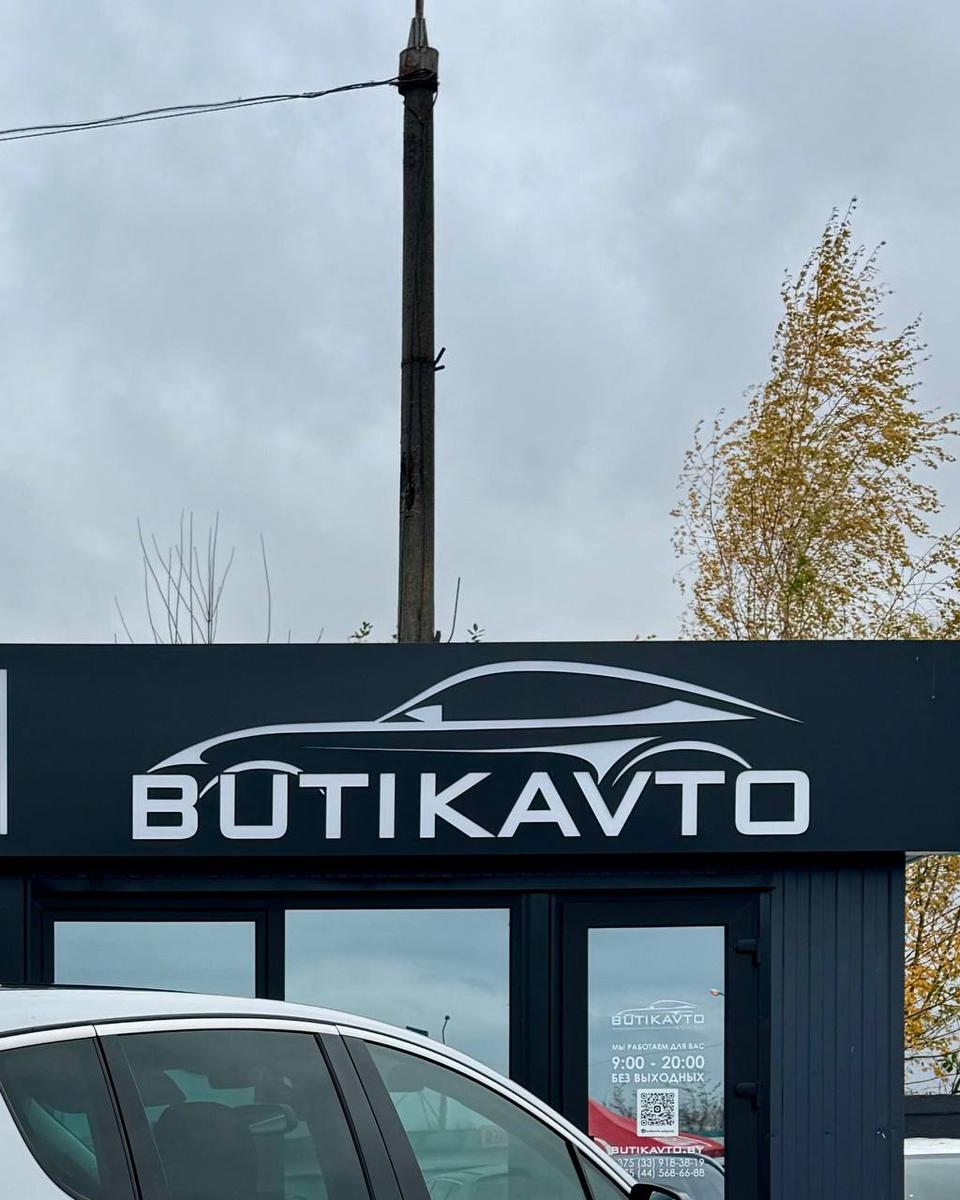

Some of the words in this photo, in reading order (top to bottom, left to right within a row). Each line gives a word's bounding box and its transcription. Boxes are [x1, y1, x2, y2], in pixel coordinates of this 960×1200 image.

[131, 769, 811, 840] BUTIKAVTO
[611, 1013, 705, 1026] BUTIKAVTO
[611, 1055, 645, 1070] 9:00
[661, 1055, 705, 1070] 20:00
[611, 1072, 631, 1084] БЕЗ
[634, 1072, 705, 1084] ВЫХОДНЫХ
[611, 1145, 705, 1155] BUTIKAVTO.BY
[637, 1158, 656, 1169] (33)
